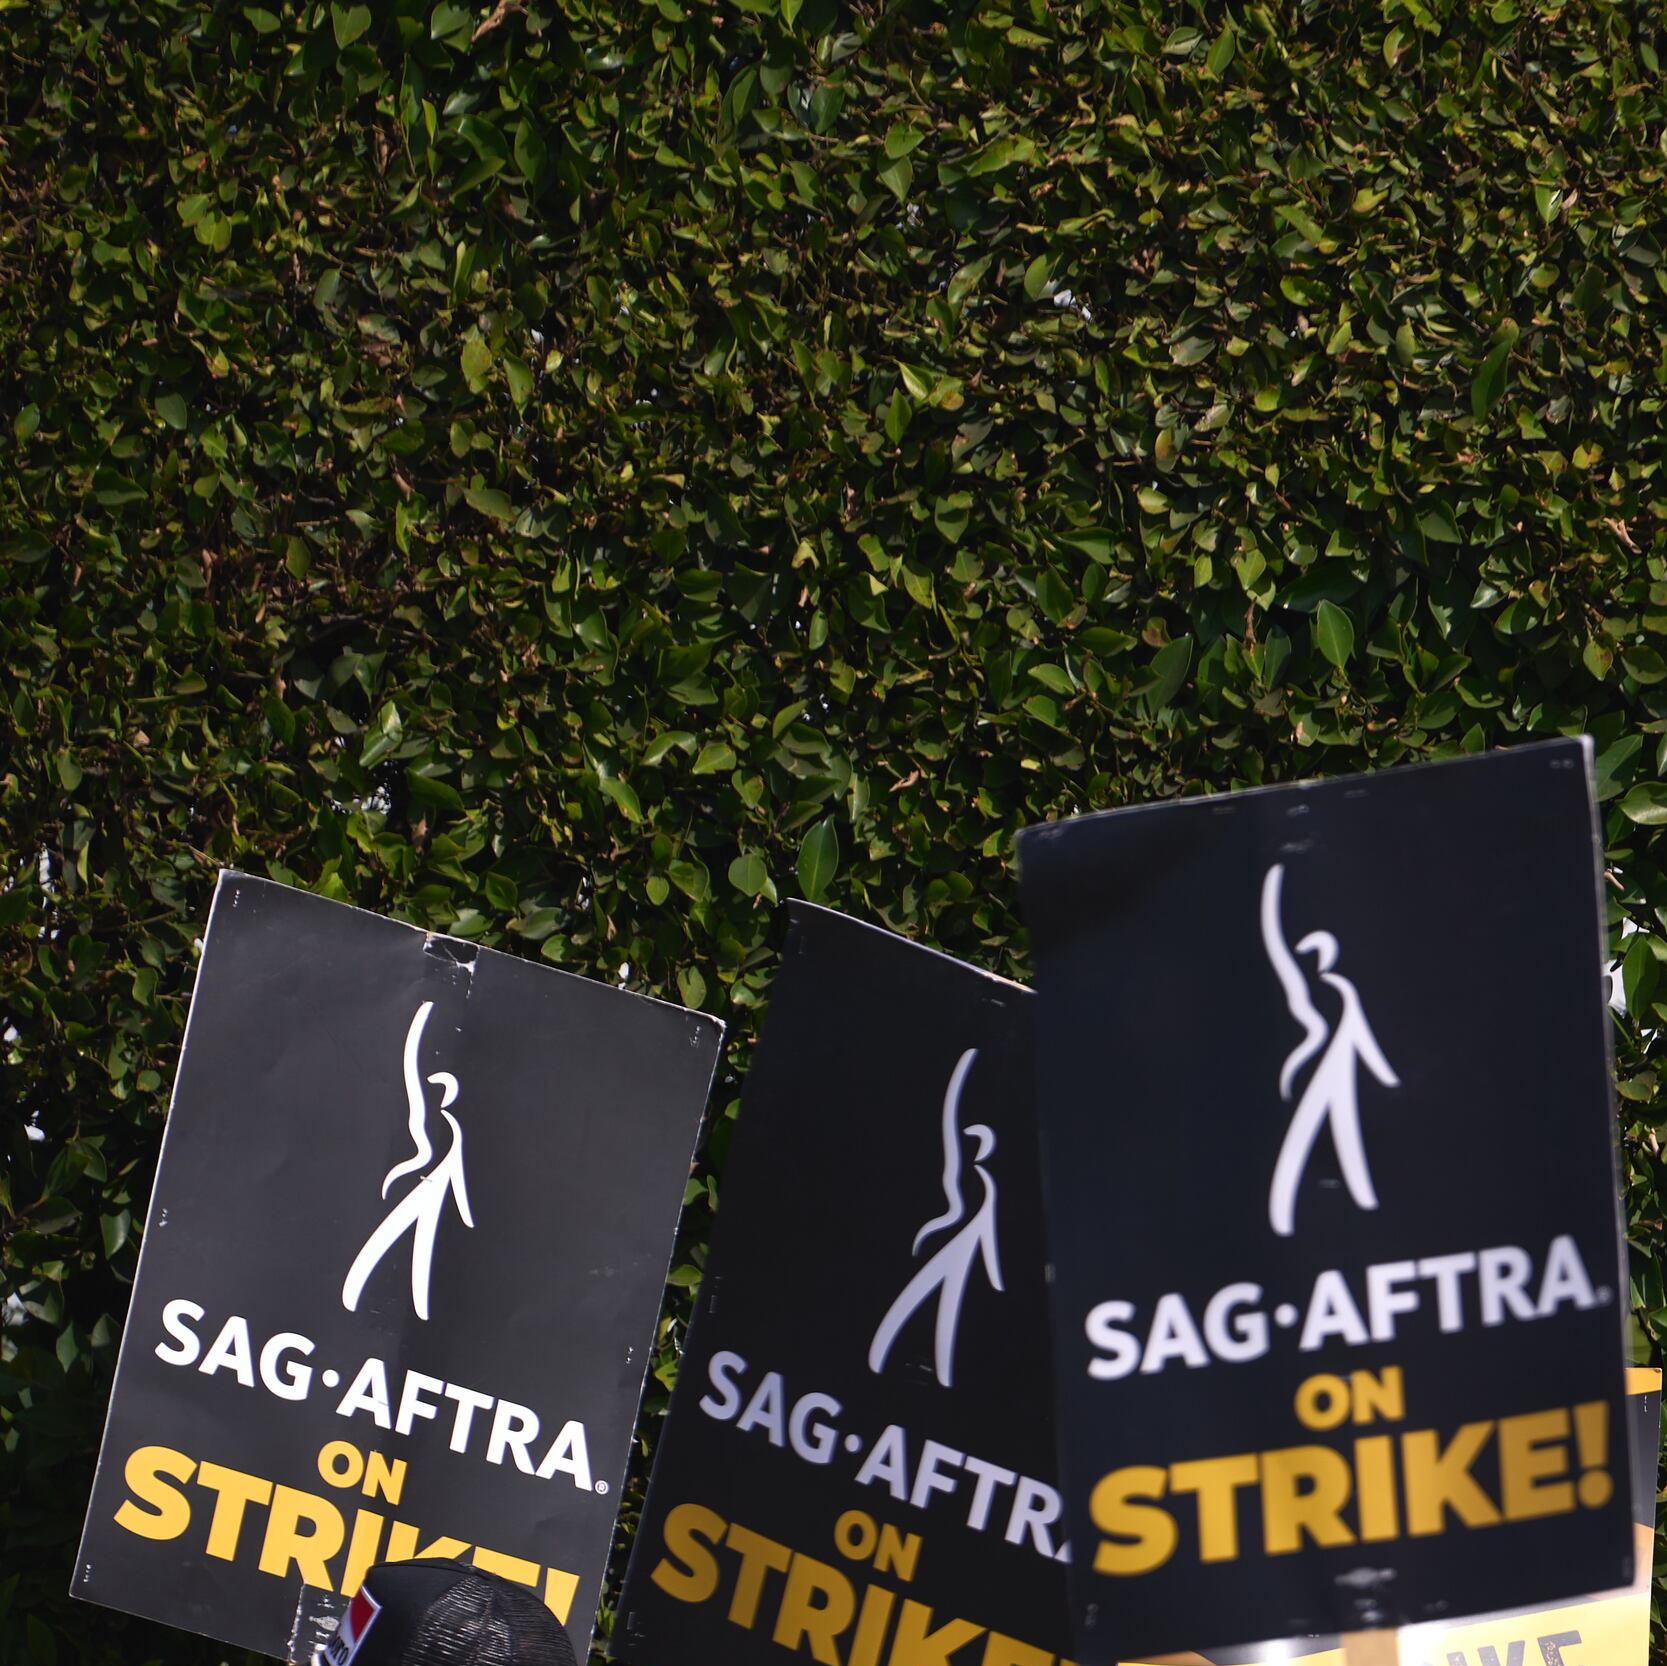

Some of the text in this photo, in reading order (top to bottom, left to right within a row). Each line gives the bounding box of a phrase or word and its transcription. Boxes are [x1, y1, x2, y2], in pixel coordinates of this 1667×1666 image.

[1294, 1365, 1404, 1430] ON
[318, 1441, 407, 1504] ON
[699, 1350, 1072, 1563] SAG·AFTR
[1089, 1400, 1613, 1576] STRIKE!
[835, 1510, 922, 1582] ON
